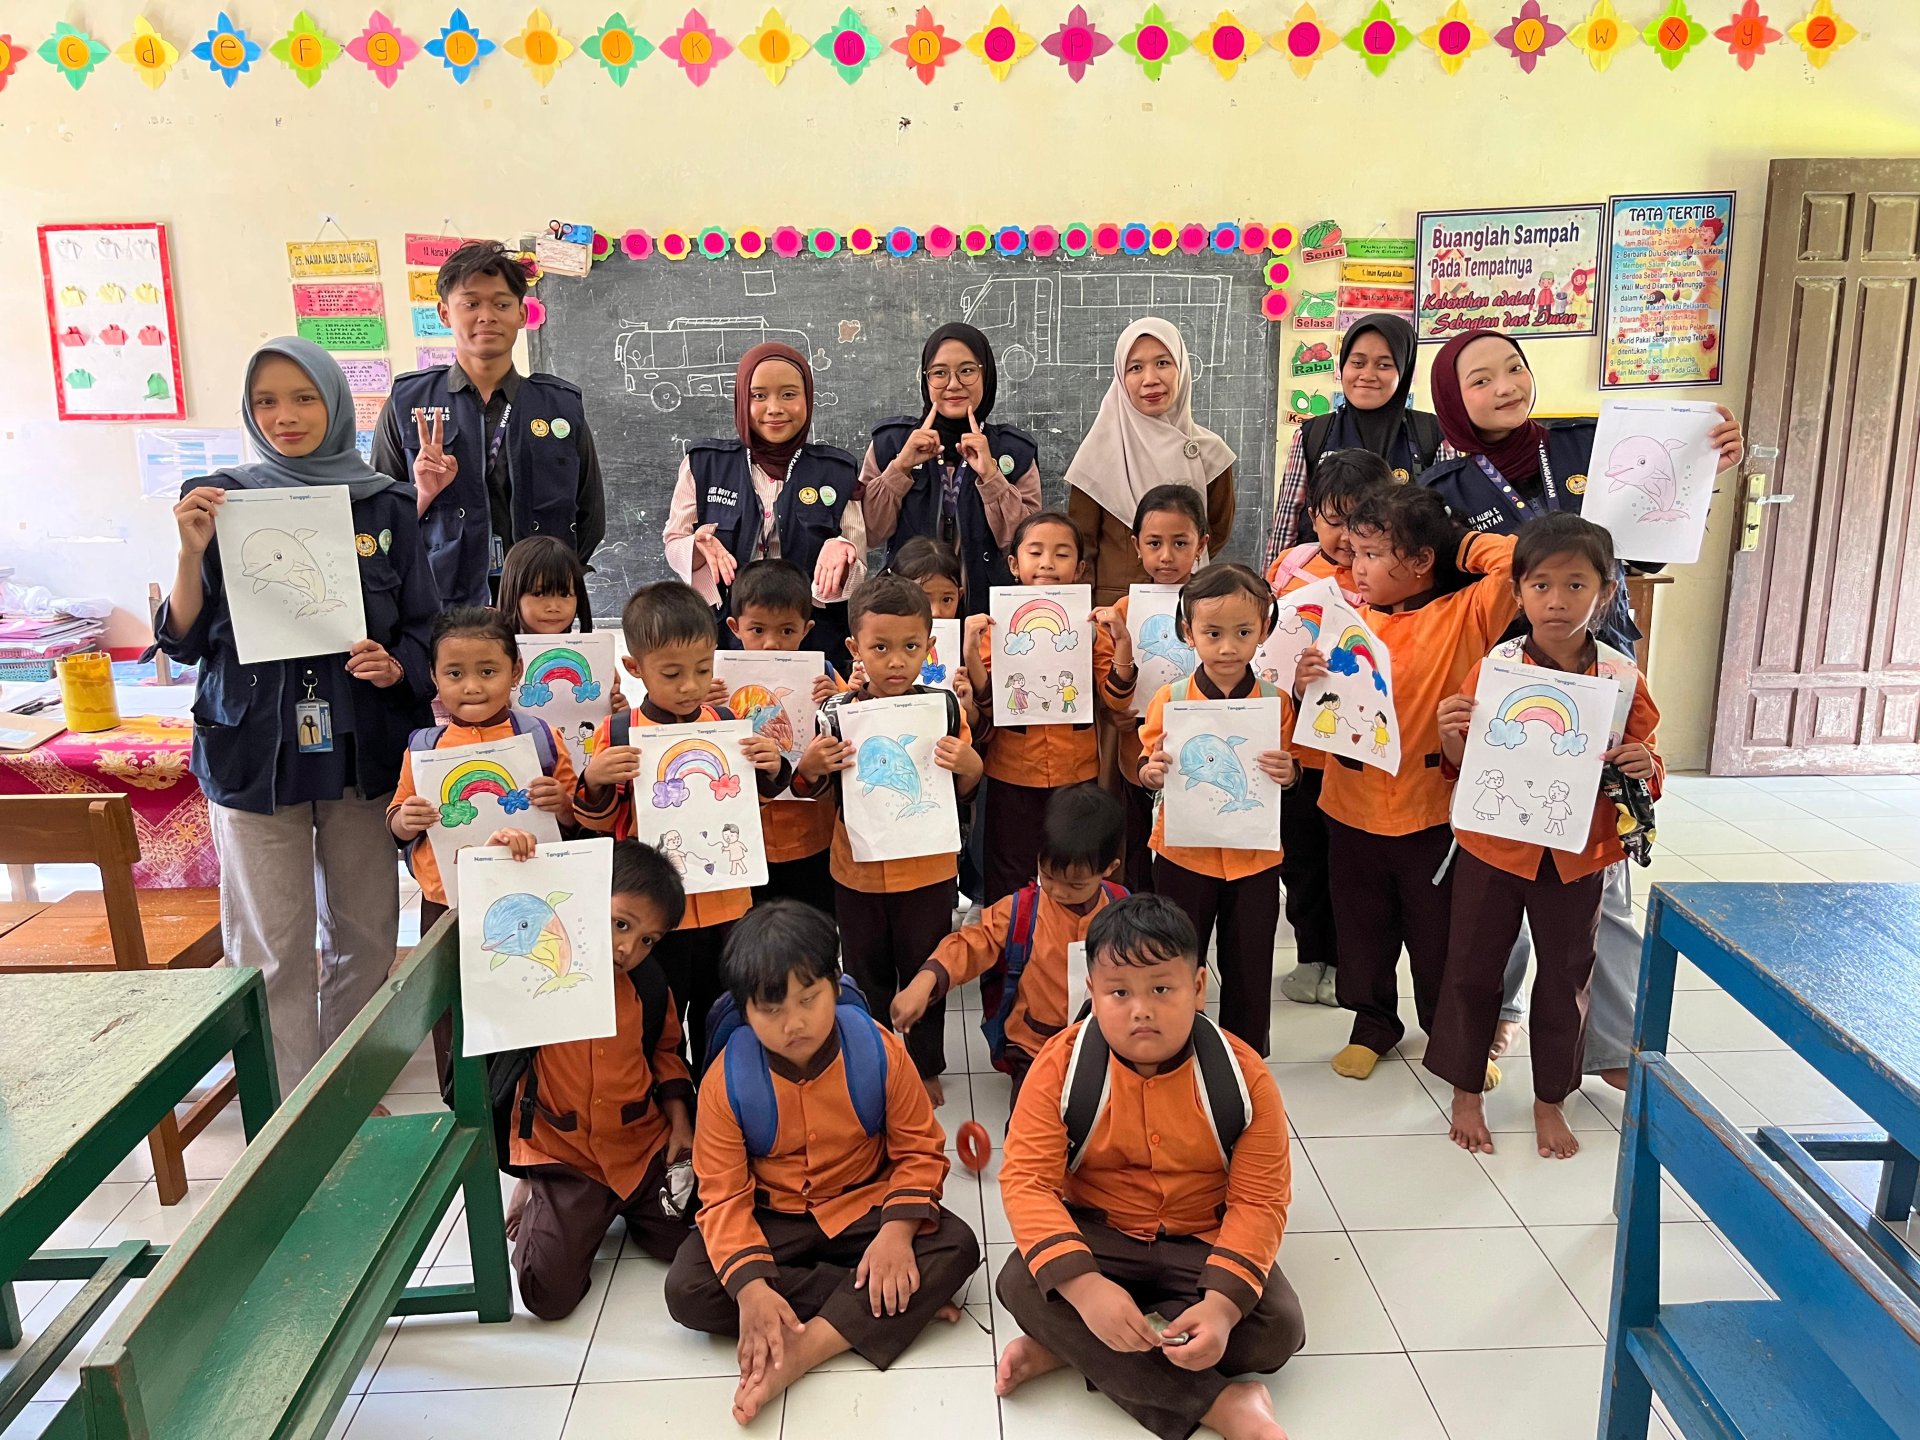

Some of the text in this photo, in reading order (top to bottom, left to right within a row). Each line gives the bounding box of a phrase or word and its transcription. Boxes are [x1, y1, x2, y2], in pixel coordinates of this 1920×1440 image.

[142, 38, 155, 64] d
[219, 39, 237, 61] e
[374, 38, 388, 61] g
[918, 37, 931, 56] n
[1629, 206, 1715, 221] TATA TERTIB
[1432, 222, 1580, 251] Buanglah Sampah
[1625, 228, 1640, 236] Murid
[1642, 228, 1661, 237] Datang
[305, 255, 321, 264] NAMA
[324, 254, 338, 264] NABI
[340, 254, 352, 263] DAN
[1305, 248, 1343, 261] Senin
[1377, 270, 1391, 278] Kepada
[1431, 256, 1532, 280] Pada Tempatnya
[1622, 272, 1642, 280] Berdoa
[1644, 271, 1668, 279] Sebelum
[1670, 271, 1695, 279] Pelajaran
[1422, 288, 1535, 311] Kebersihan adalah
[1620, 305, 1643, 313] Dilarang
[1296, 318, 1333, 328] Selasa
[1430, 310, 1577, 334] Sebagian dari Iman
[1652, 336, 1676, 344] Seragam
[1676, 356, 1695, 364] Pulang
[1294, 361, 1332, 375] Rabu
[1539, 448, 1556, 498] KARANGANYAR
